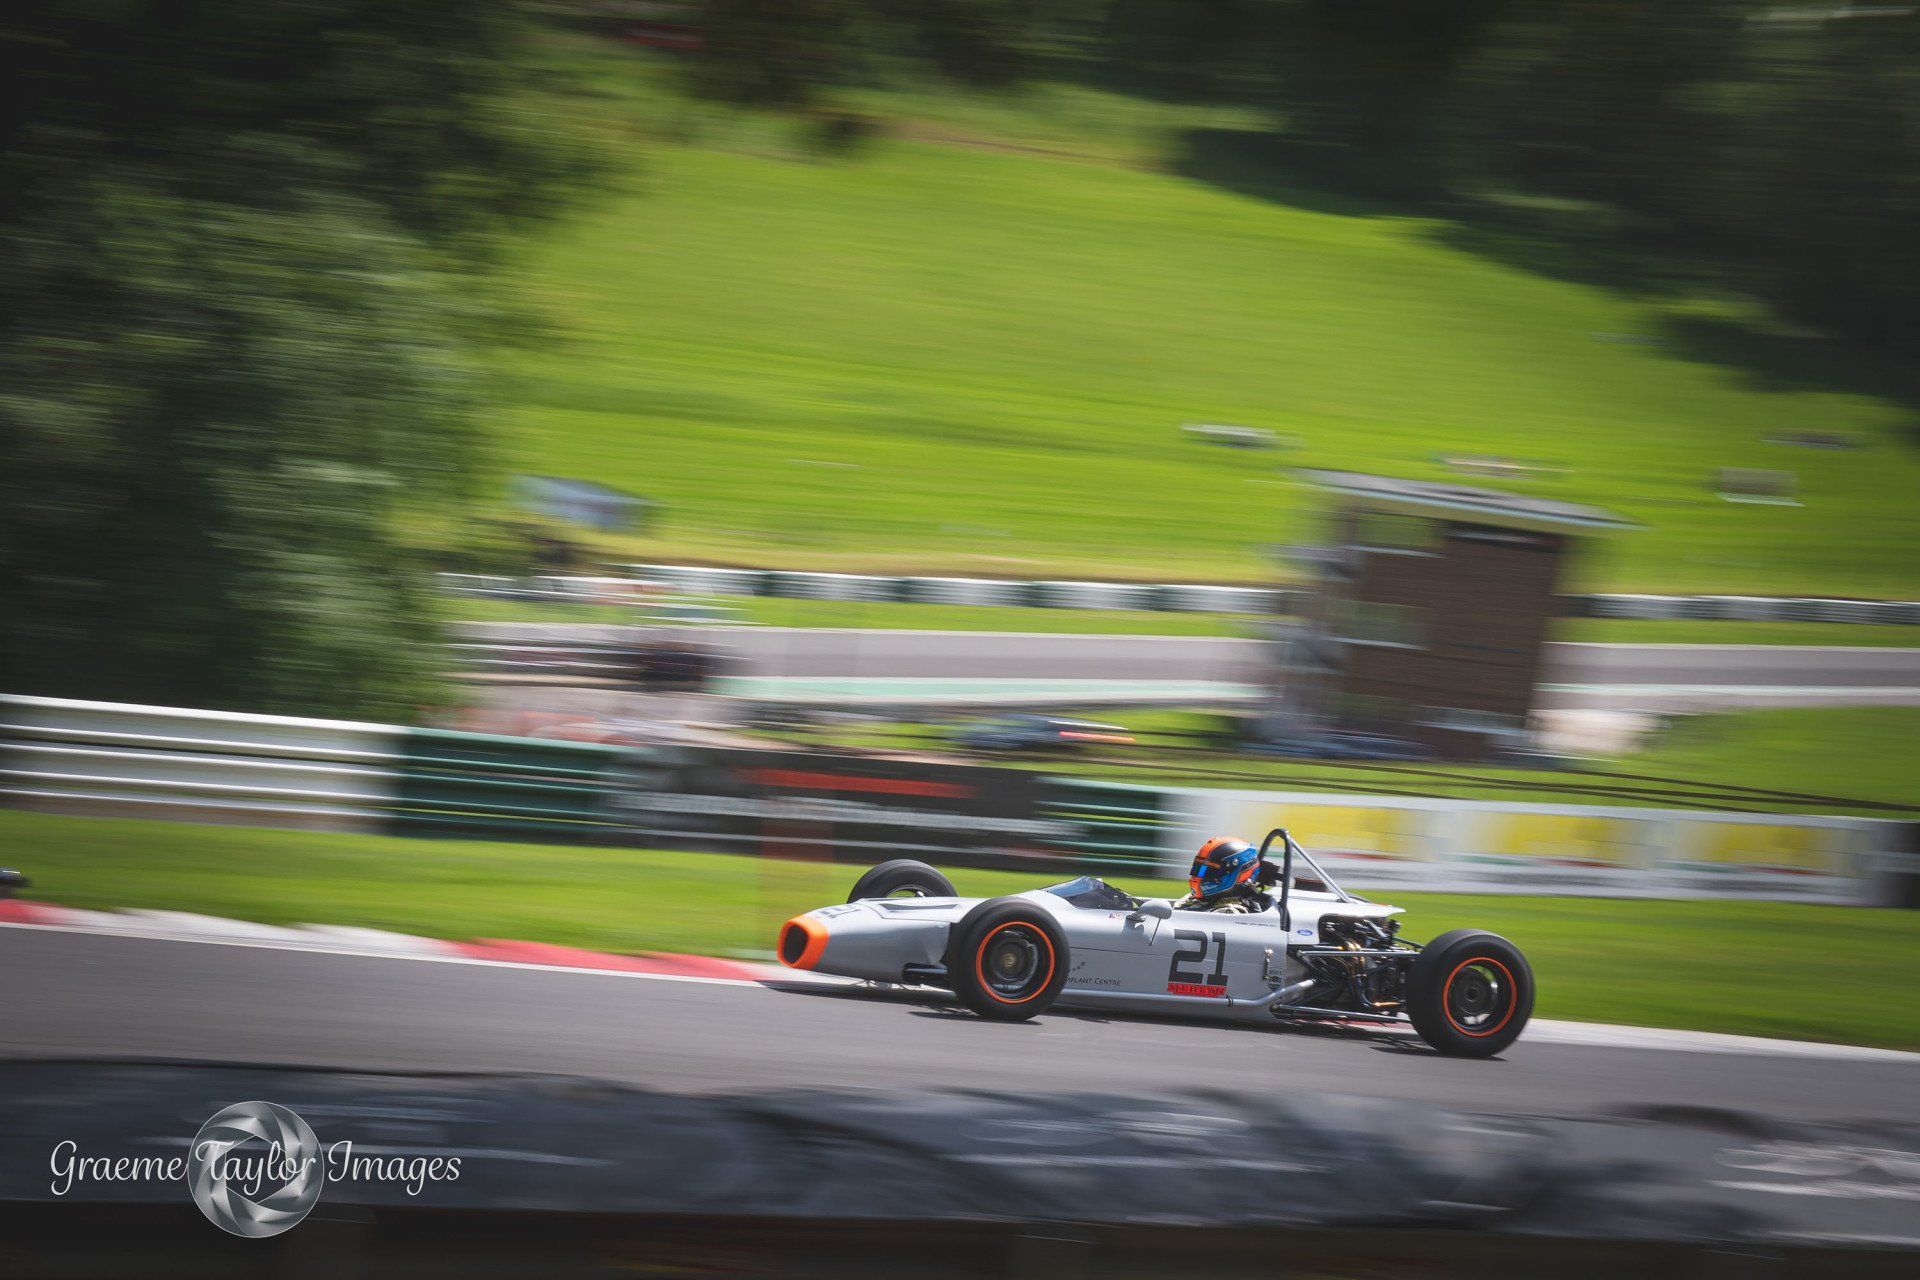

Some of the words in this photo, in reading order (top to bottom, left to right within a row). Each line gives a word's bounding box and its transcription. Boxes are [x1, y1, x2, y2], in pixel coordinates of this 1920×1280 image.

[1168, 929, 1229, 986] 21
[1064, 976, 1092, 984] MPLANT
[1094, 977, 1121, 987] CENTRE
